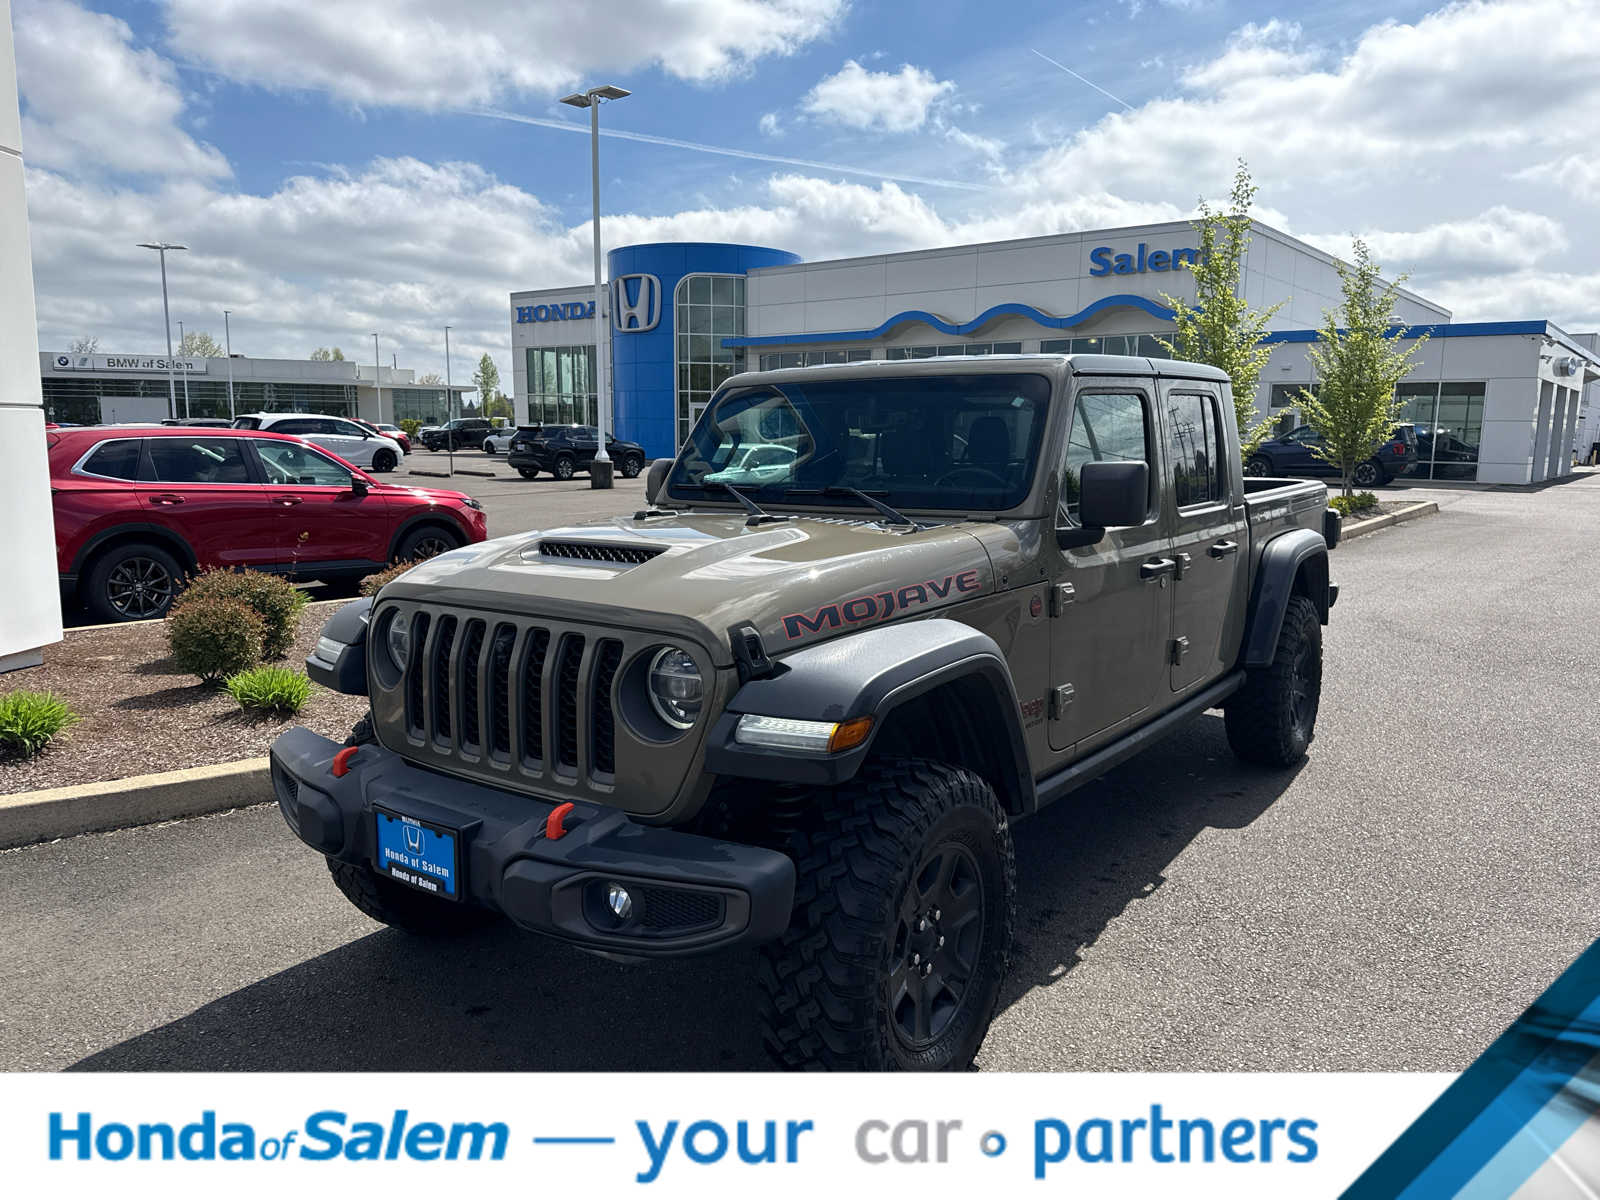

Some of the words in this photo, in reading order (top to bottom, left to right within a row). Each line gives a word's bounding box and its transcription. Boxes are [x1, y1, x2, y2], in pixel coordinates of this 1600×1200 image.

[1089, 243, 1208, 277] Salem
[107, 358, 139, 368] BMW
[142, 359, 154, 369] of
[781, 569, 982, 640] MOJAVE
[385, 847, 409, 864] Honda
[411, 858, 419, 868] of
[422, 861, 449, 878] Salem
[391, 867, 409, 882] Honda
[411, 876, 417, 884] of
[418, 877, 437, 891] Salem
